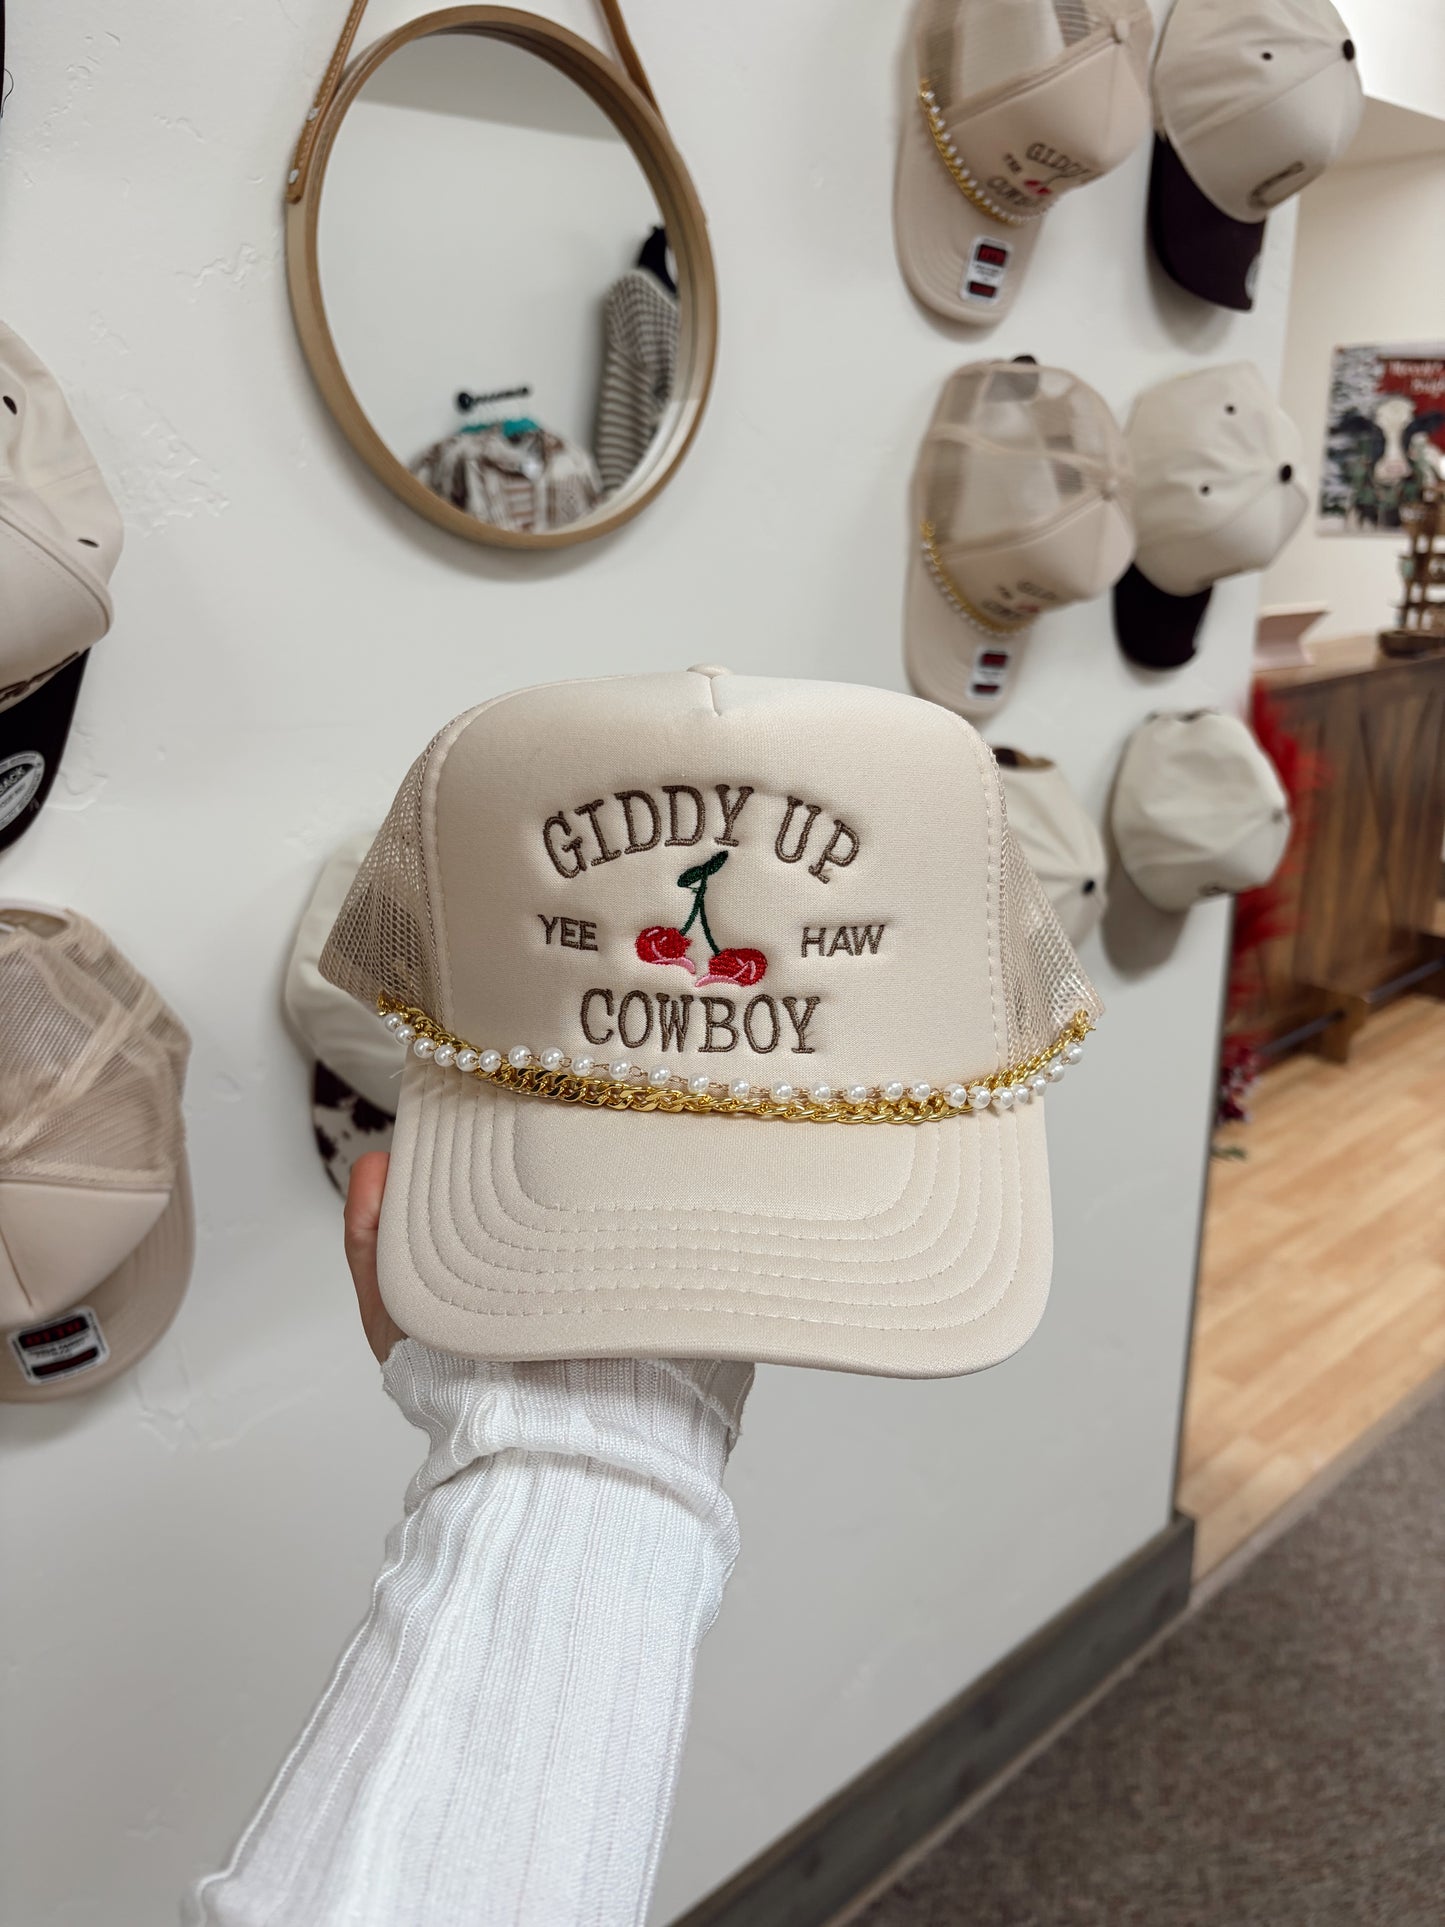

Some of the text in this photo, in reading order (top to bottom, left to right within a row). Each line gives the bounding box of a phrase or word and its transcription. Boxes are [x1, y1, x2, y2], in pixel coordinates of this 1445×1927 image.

[542, 784, 861, 884] GIDDY UP
[538, 914, 885, 958] YEE HAW
[580, 988, 820, 1054] COWBOY
